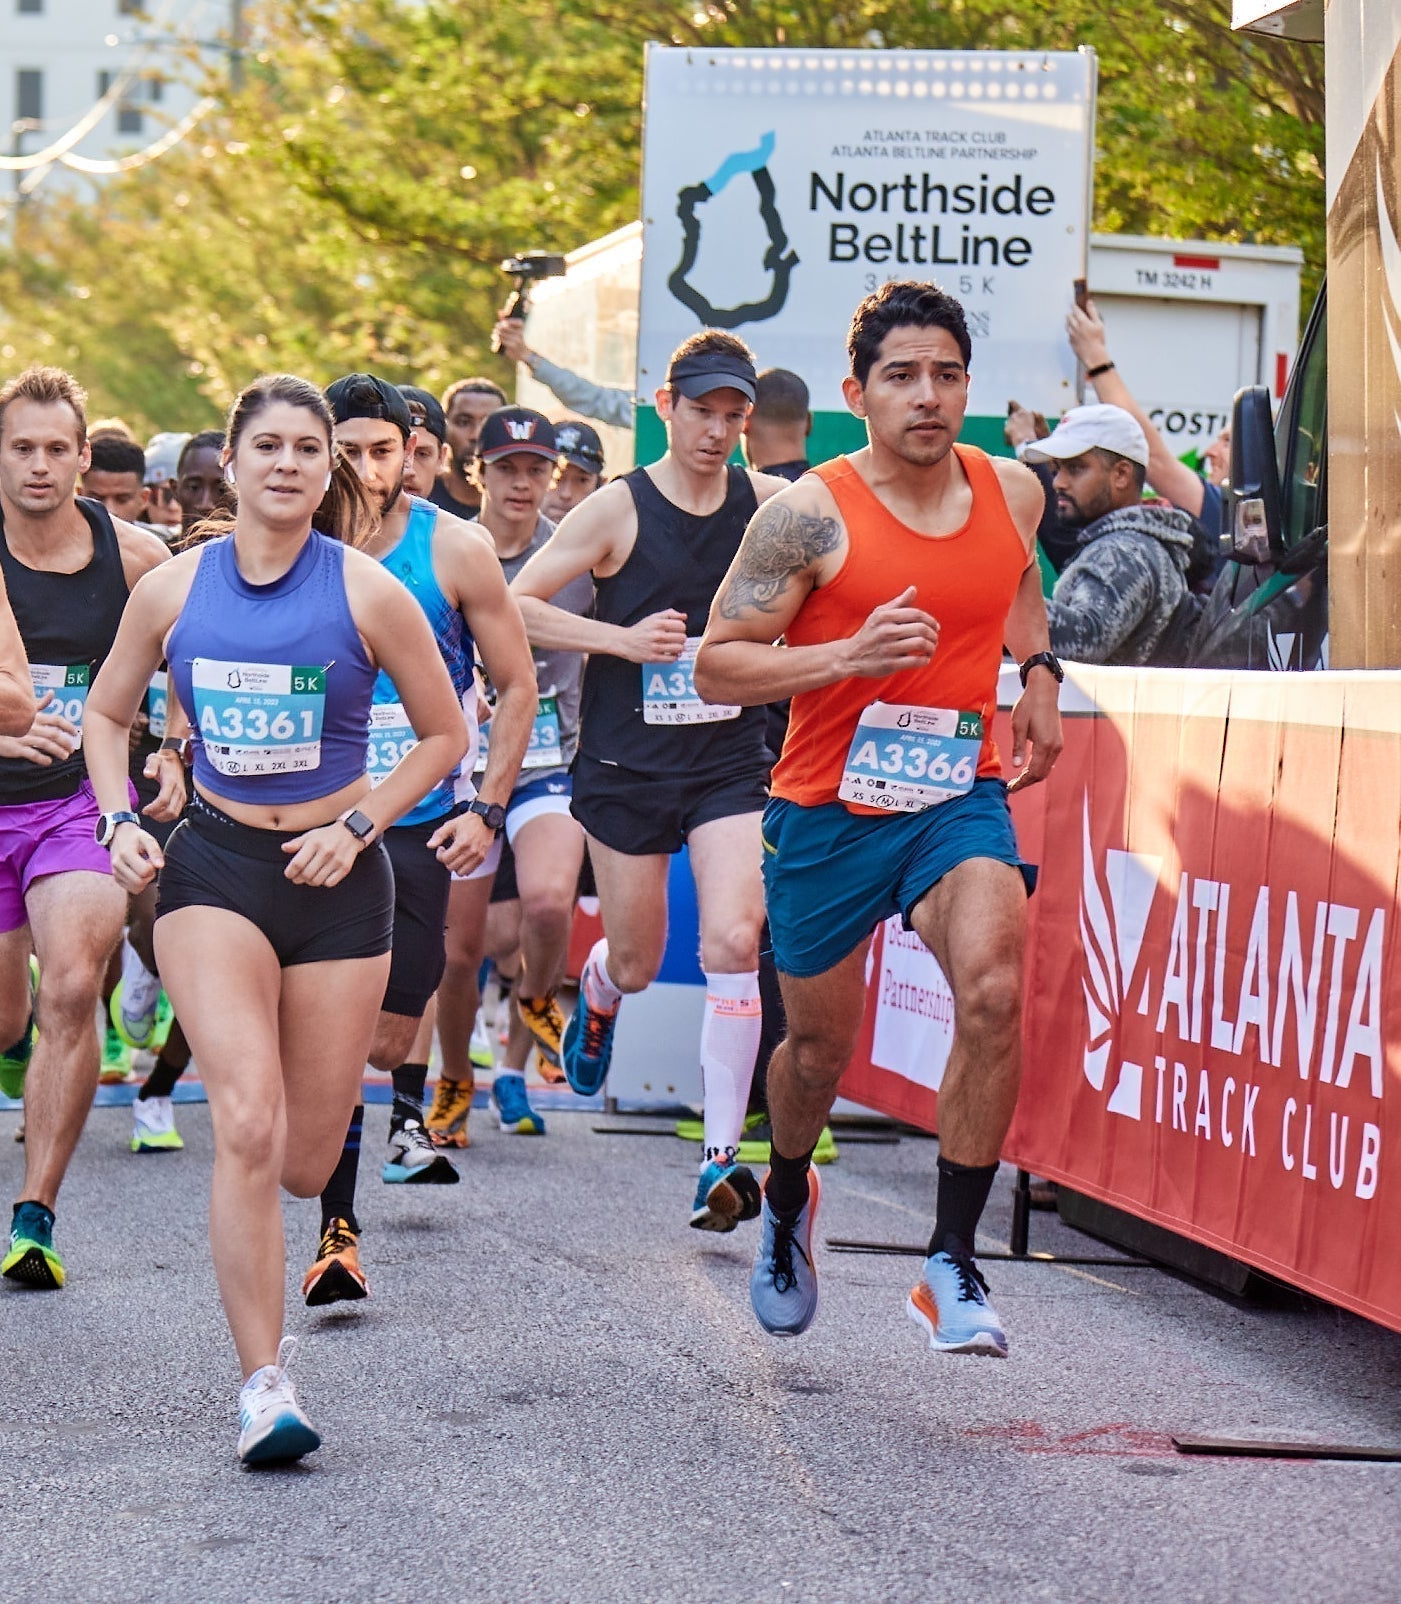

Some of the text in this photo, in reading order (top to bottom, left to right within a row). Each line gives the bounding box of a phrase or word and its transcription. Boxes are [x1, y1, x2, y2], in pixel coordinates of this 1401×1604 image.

[831, 146, 1038, 160] ATLANTA BELTLINE PARTNERSHIP
[863, 130, 1006, 144] ATLANTA TRACK CLUB
[809, 172, 1055, 215] Northside
[828, 222, 1032, 266] BeltLine
[1135, 269, 1212, 290] TM 3242 H
[1149, 410, 1227, 435] COST
[201, 705, 314, 740] A3361
[851, 741, 973, 785] A3366
[883, 969, 953, 1034] Partnership
[1156, 872, 1385, 1098] ATLANTA
[1154, 1055, 1381, 1200] TRACK CLUB
